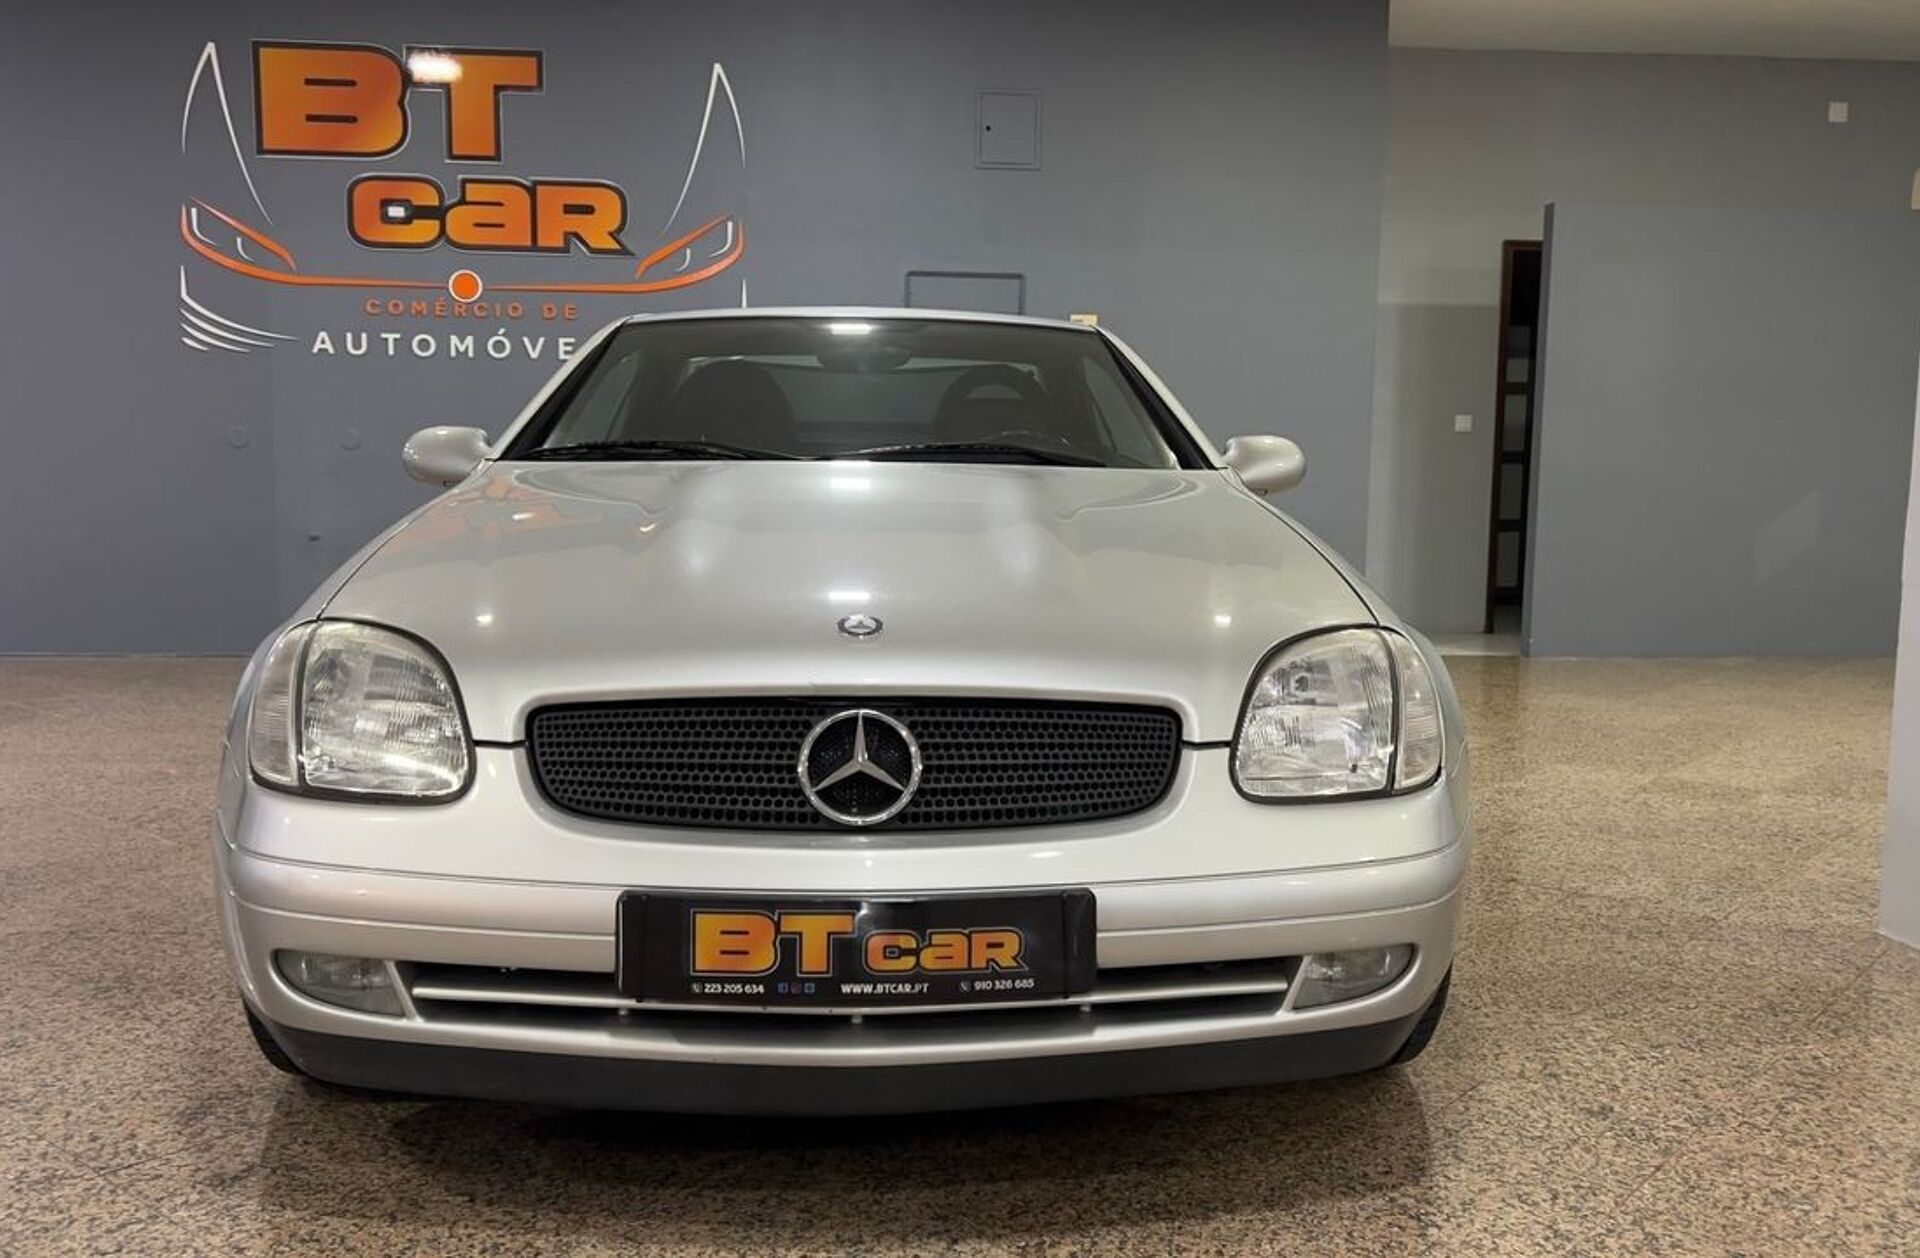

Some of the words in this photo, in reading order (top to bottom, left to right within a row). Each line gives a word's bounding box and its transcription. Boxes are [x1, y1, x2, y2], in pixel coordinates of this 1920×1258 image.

[252, 40, 543, 163] BT
[365, 297, 524, 319] COMÉRCIO
[542, 304, 579, 320] DE
[691, 909, 856, 976] BT
[704, 982, 722, 994] 223
[723, 982, 743, 994] 205
[744, 983, 765, 994] 634
[840, 983, 930, 994] WWW.BTCAR.PT
